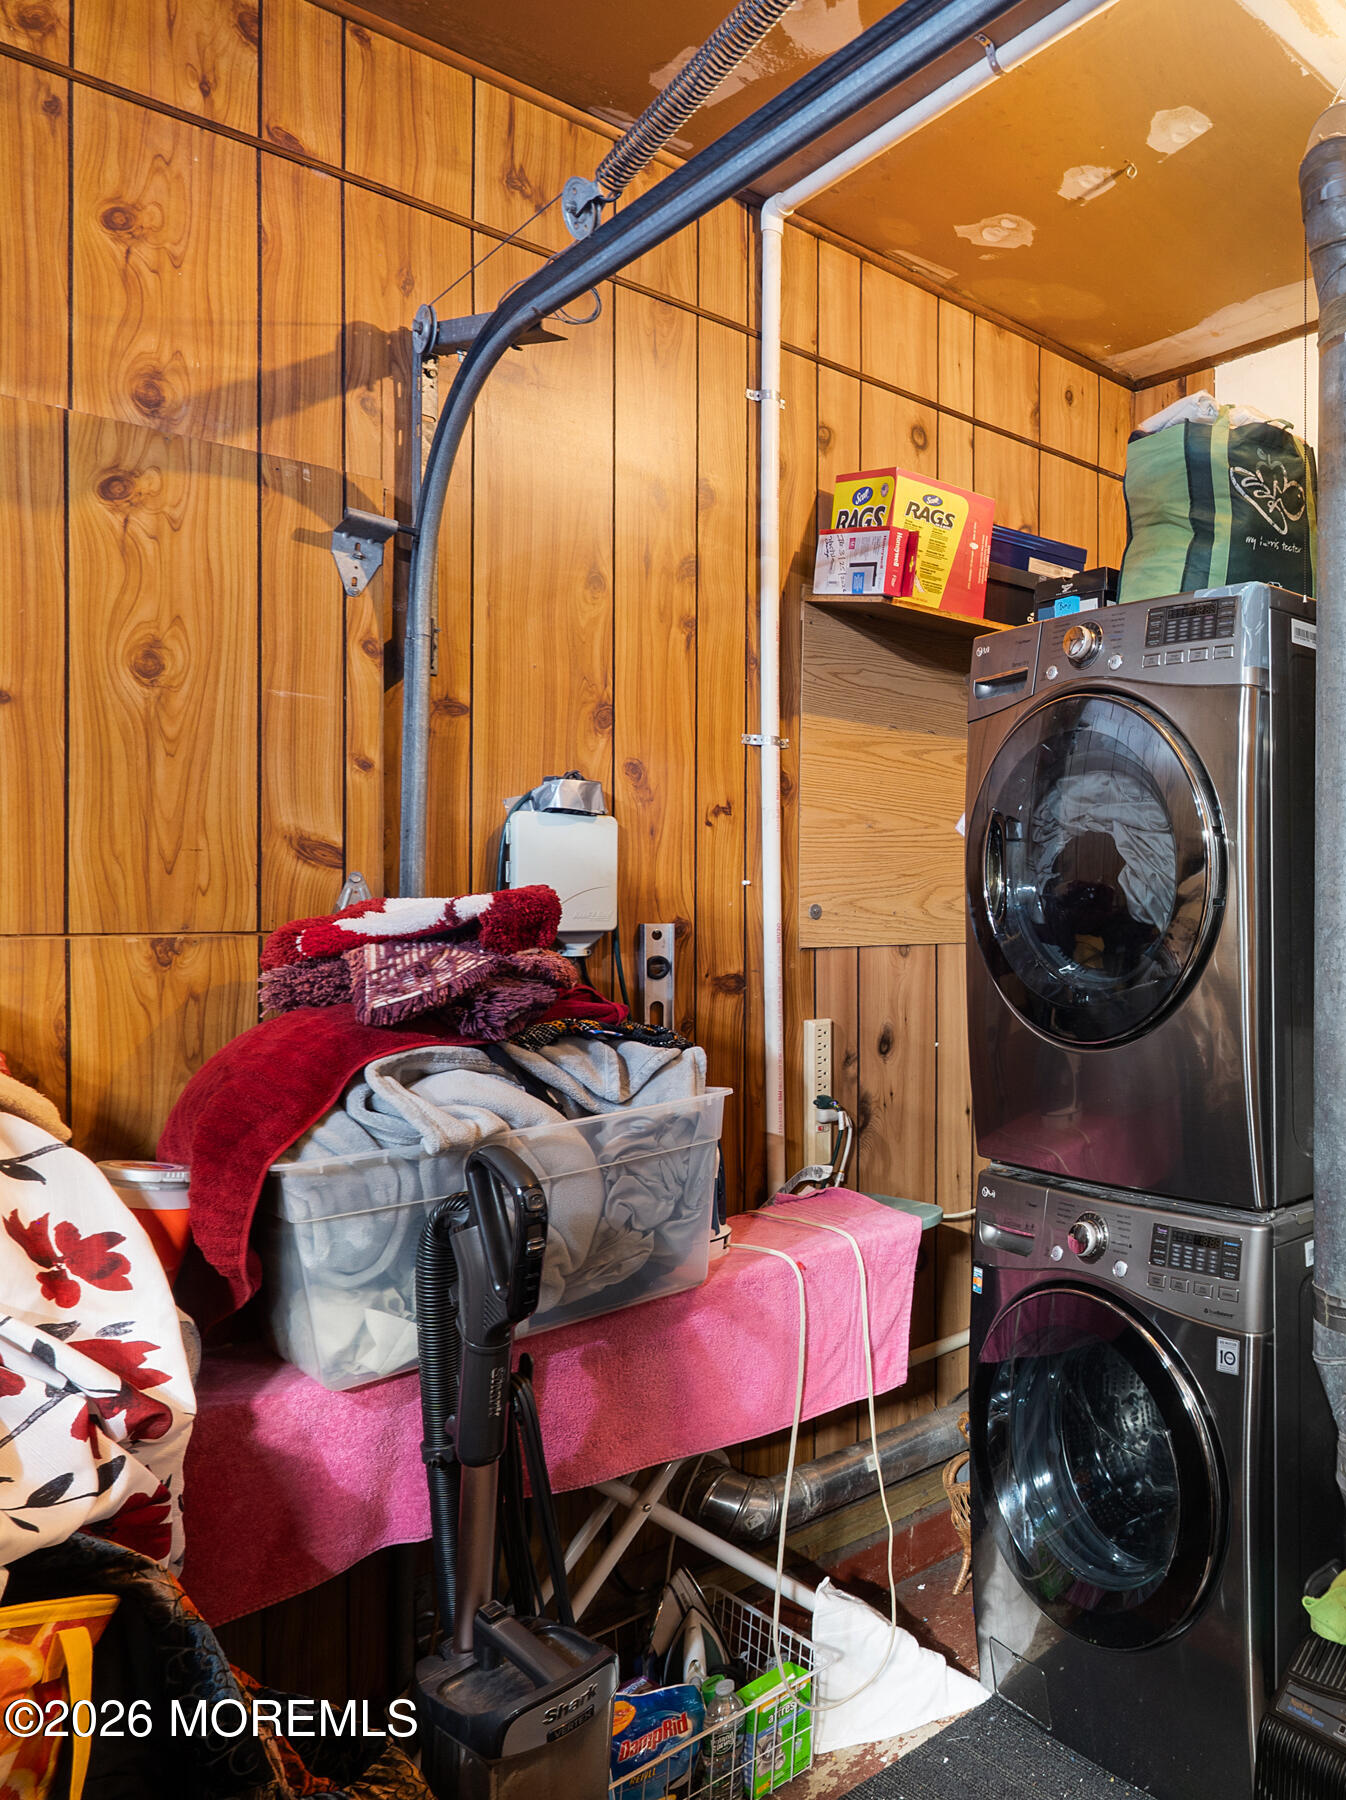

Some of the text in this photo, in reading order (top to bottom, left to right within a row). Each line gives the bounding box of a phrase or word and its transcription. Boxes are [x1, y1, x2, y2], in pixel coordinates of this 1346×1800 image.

[836, 505, 886, 528] RAGS
[905, 501, 955, 529] RAGS
[893, 532, 903, 567] Honeywell
[541, 1683, 598, 1726] Shark
[618, 1712, 689, 1763] DampRid
